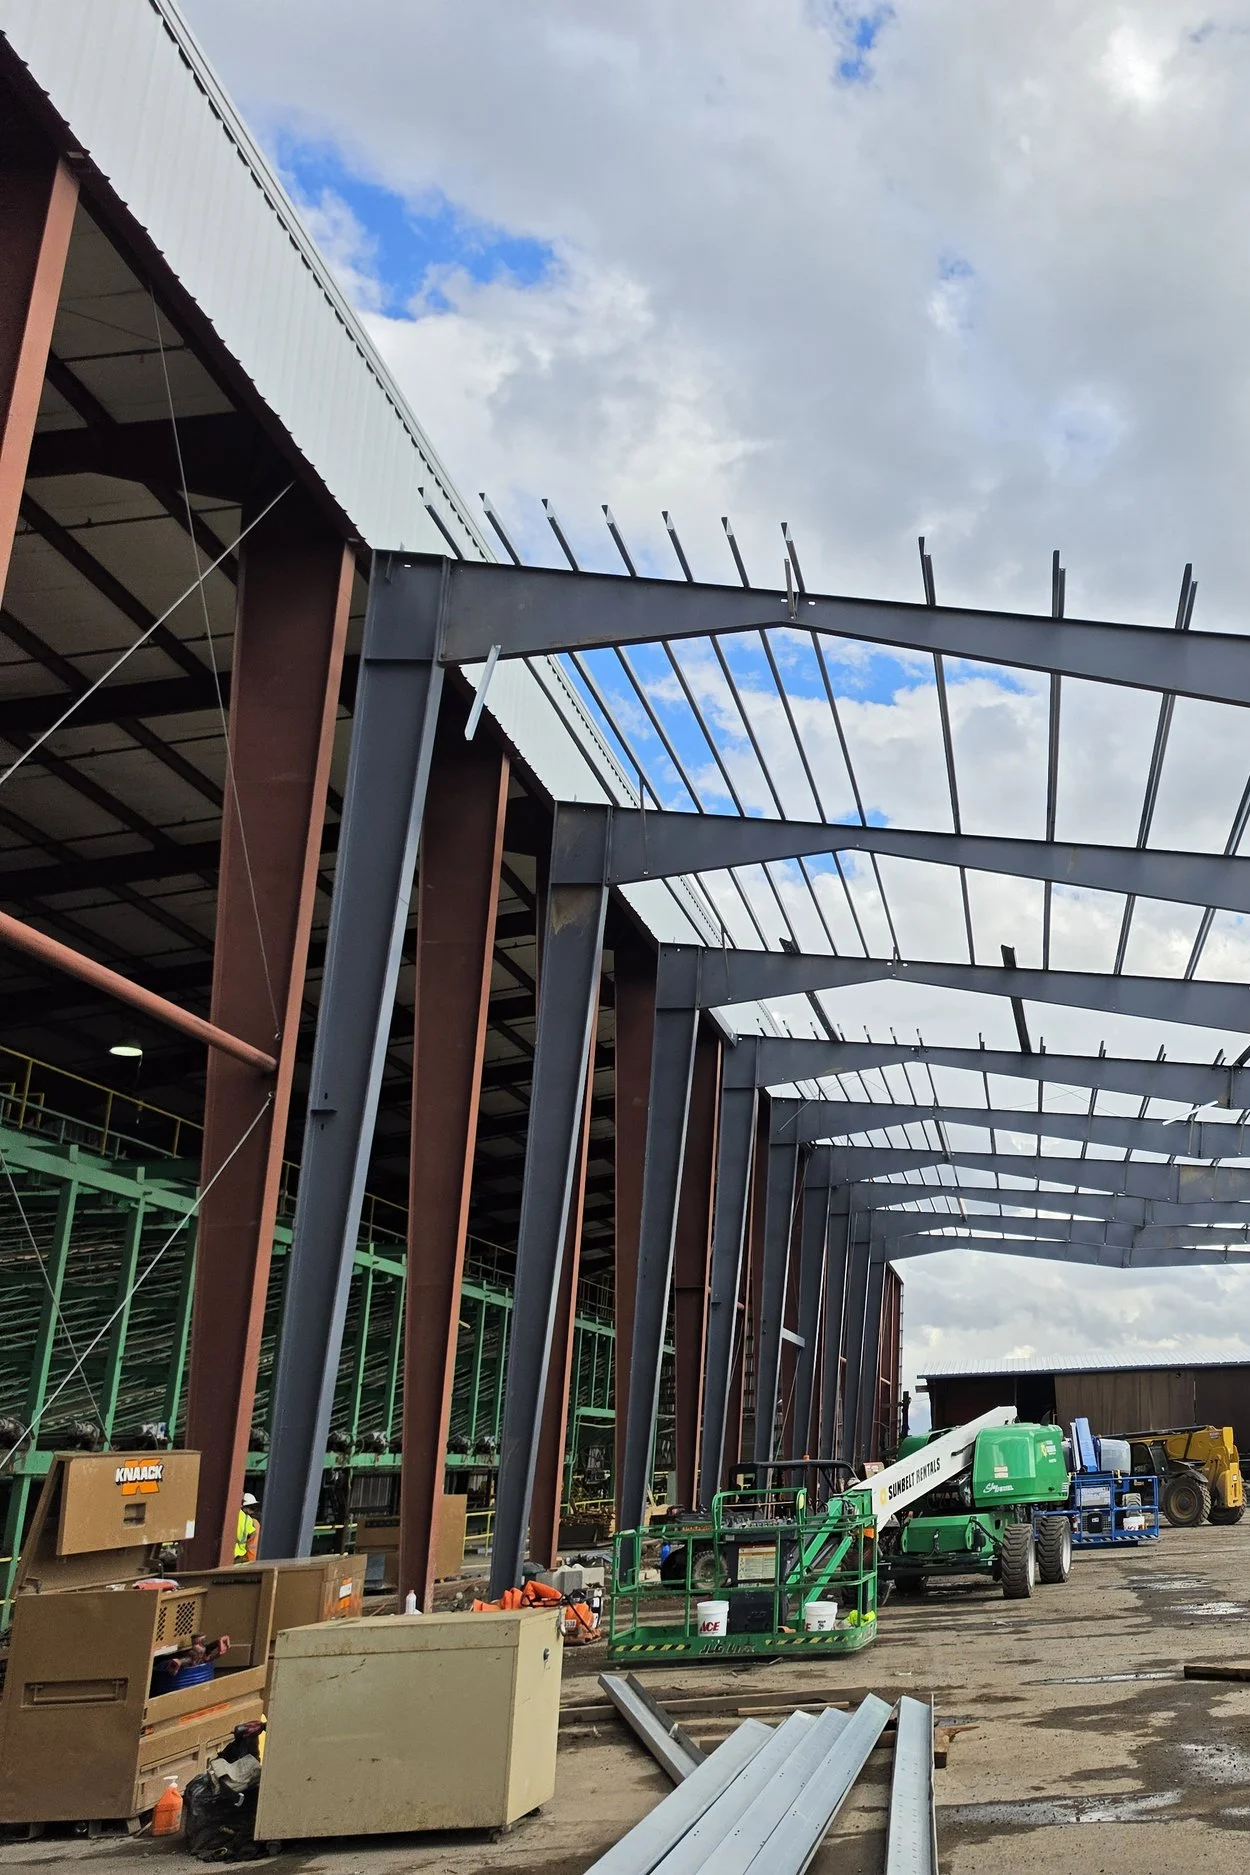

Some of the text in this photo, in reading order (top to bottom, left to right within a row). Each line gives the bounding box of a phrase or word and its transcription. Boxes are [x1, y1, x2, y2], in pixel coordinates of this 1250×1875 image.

[115, 1464, 164, 1485] KNAACK
[888, 1457, 941, 1500] SUNBELT RENTALS
[700, 1621, 720, 1632] ACE
